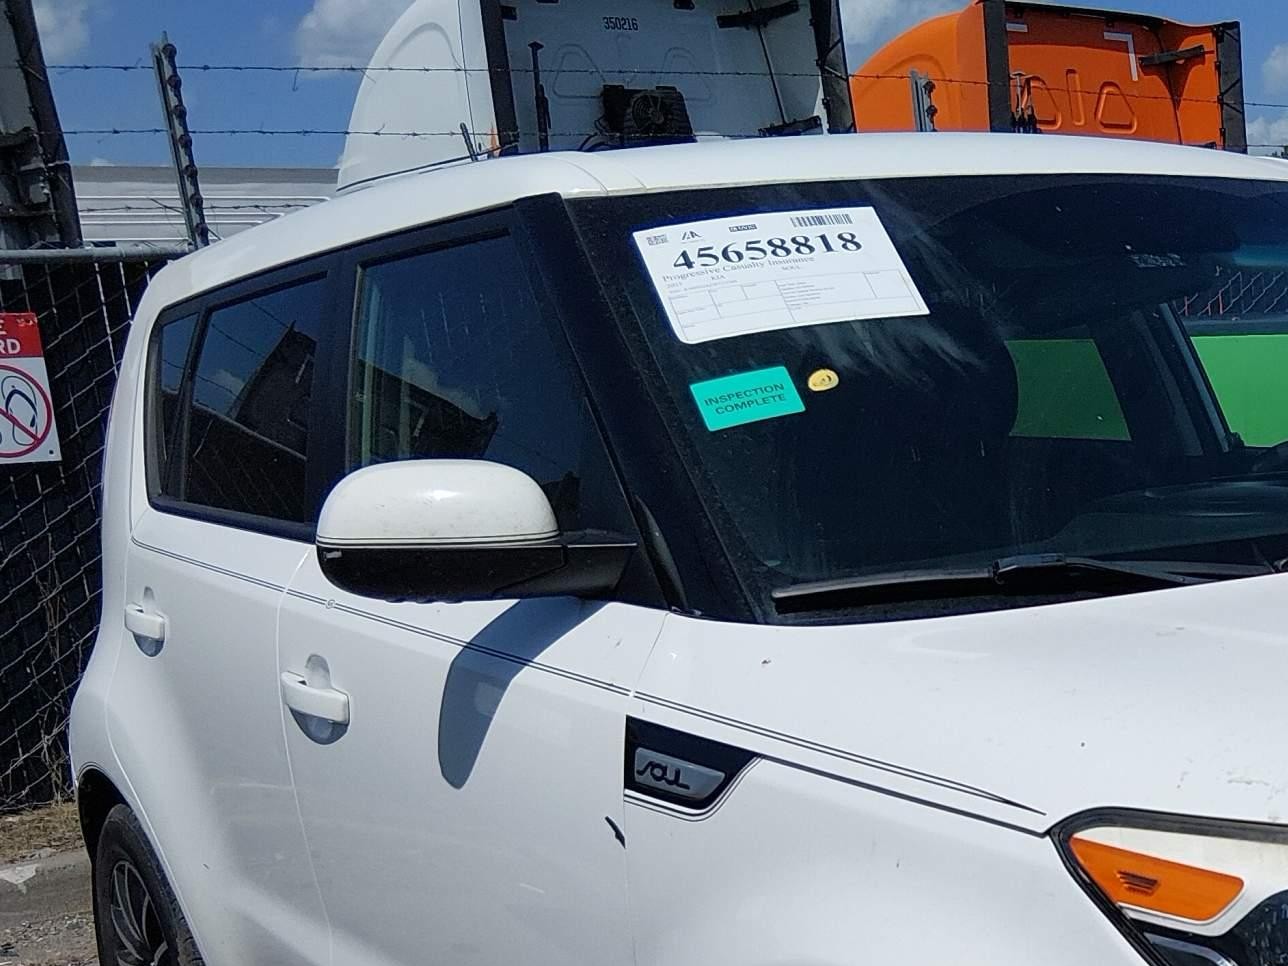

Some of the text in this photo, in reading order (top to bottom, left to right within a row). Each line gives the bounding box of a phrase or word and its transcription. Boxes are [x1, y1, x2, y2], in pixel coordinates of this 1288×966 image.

[602, 16, 639, 31] 350216
[673, 232, 862, 269] 45658818
[662, 267, 721, 282] Progressive
[722, 261, 765, 272] Casualty
[704, 383, 785, 406] INSPECTION
[715, 393, 786, 415] COMPLETE
